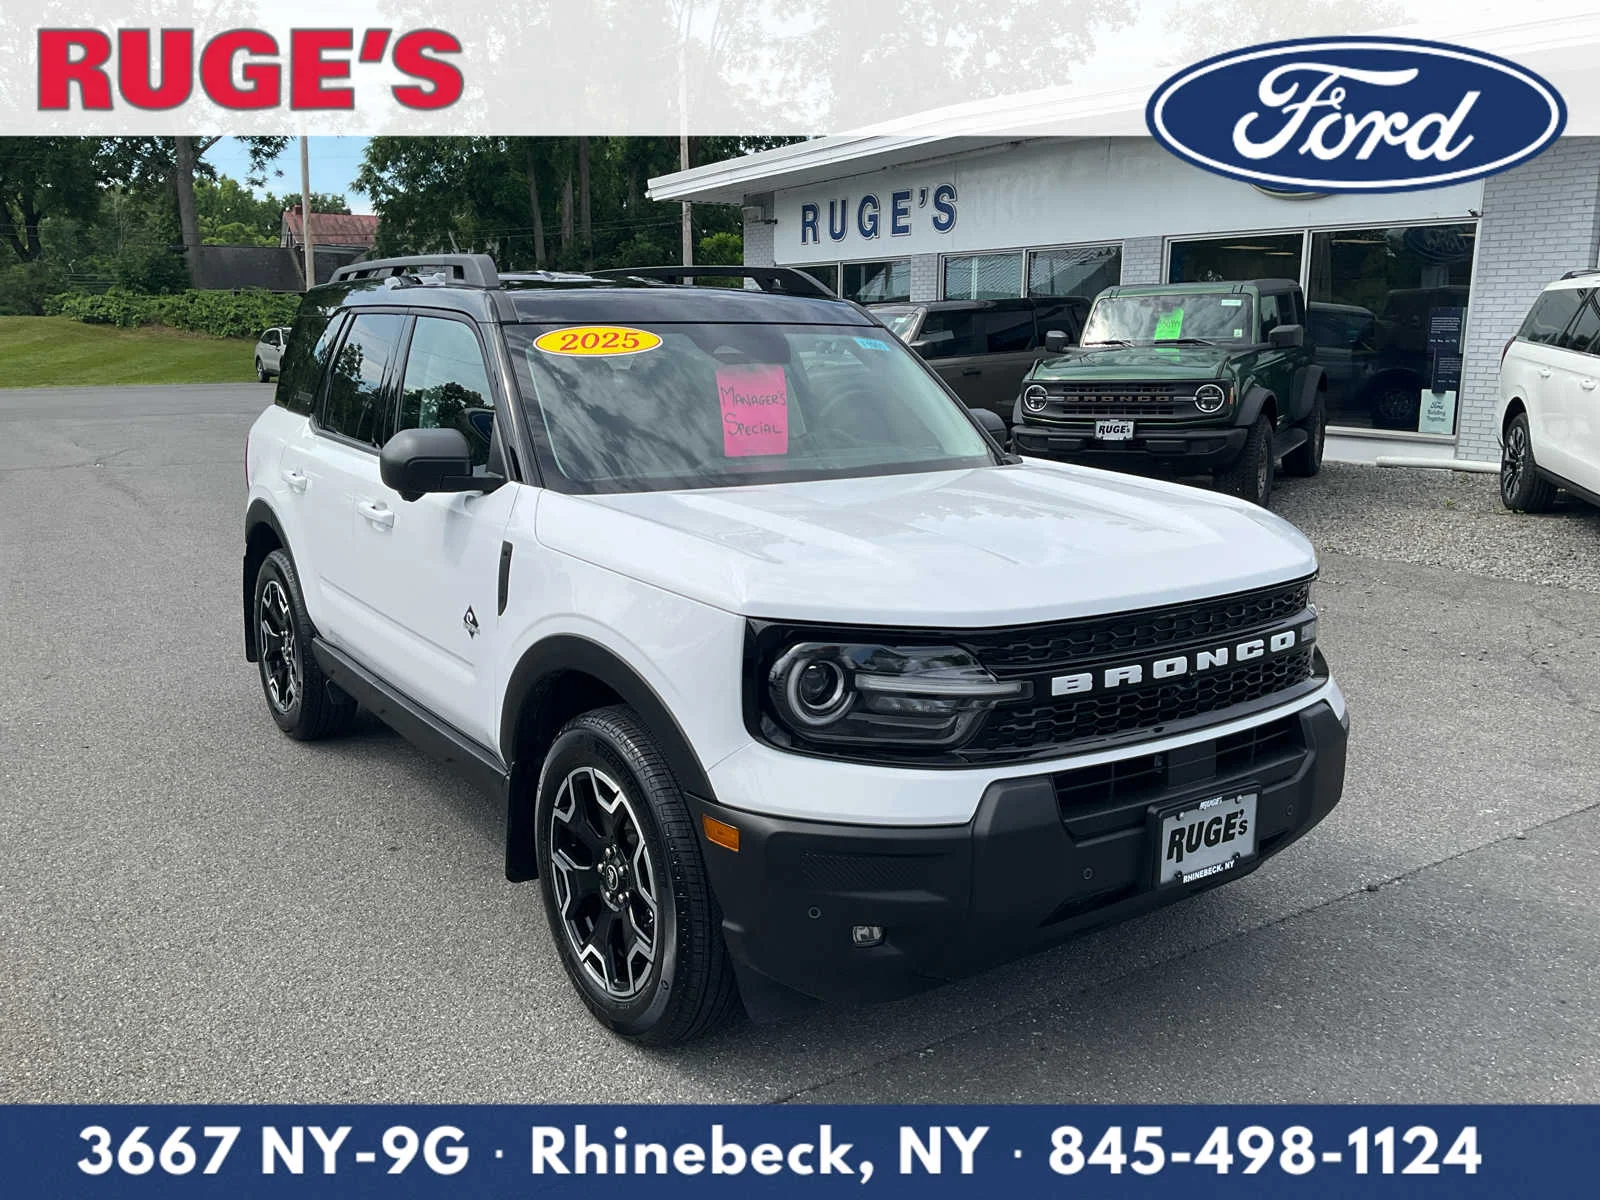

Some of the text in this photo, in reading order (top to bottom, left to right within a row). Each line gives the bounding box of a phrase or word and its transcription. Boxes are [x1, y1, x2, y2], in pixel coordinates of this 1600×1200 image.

[800, 183, 958, 245] RUGE'S
[559, 332, 640, 351] 2025
[1051, 630, 1296, 697] BRONCO
[1182, 859, 1235, 884] RHINEBECK, NY
